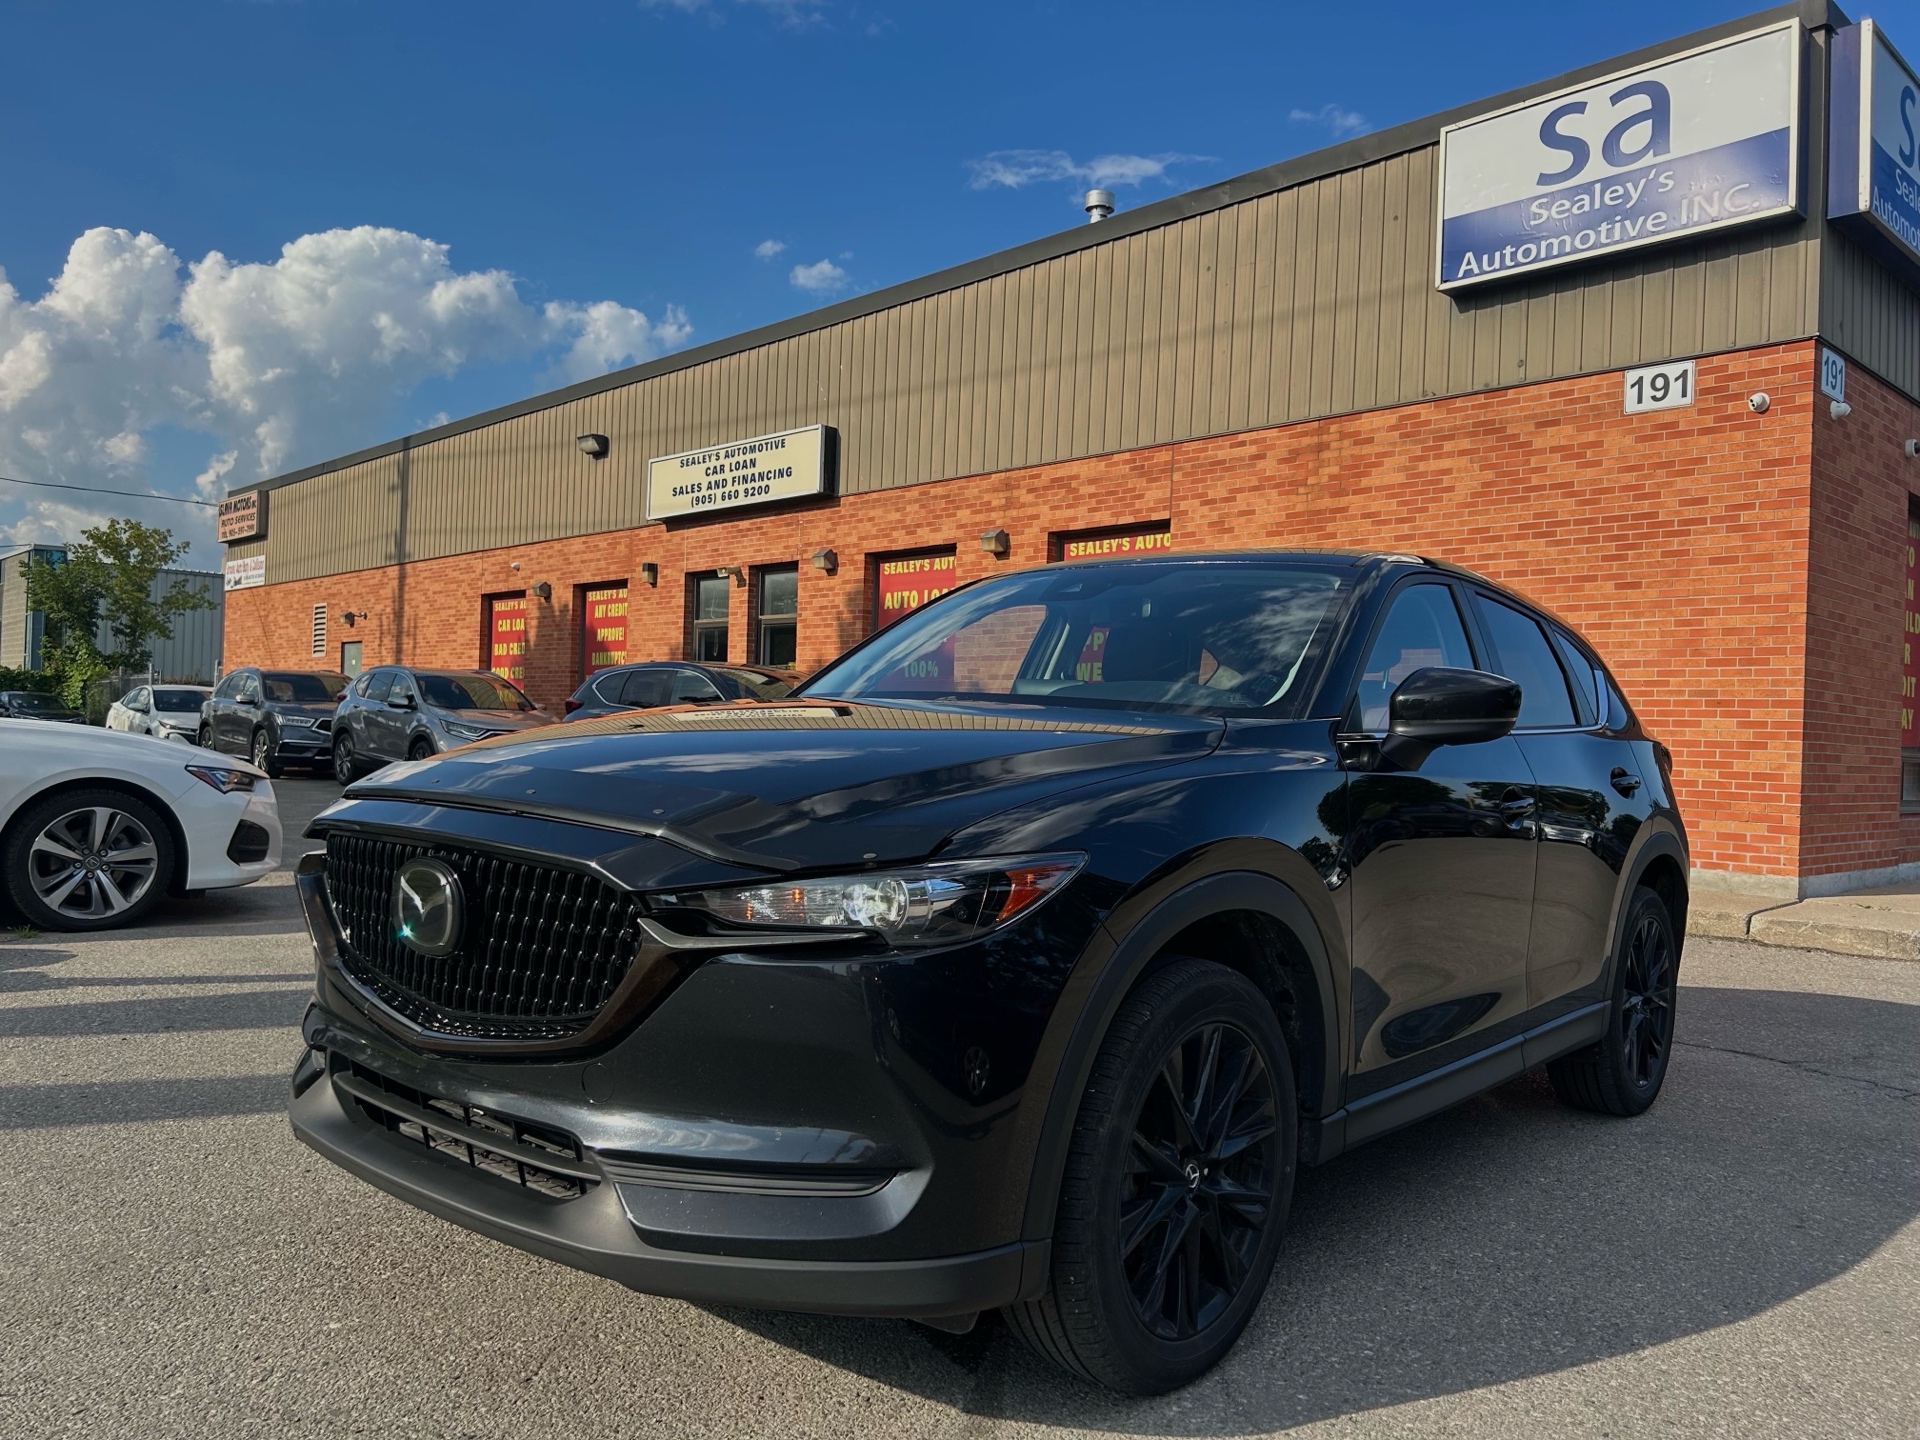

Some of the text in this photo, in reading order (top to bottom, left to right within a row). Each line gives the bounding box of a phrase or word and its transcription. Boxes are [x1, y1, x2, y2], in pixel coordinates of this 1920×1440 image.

[1536, 80, 1671, 186] sa
[1899, 85, 1920, 172] s
[1530, 169, 1674, 227] Sealey's
[1457, 183, 1760, 278] Automotive INC.
[1823, 355, 1844, 395] 191
[1629, 368, 1689, 405] 191
[680, 438, 786, 469] SEALEY'S AUTOMOTIVE
[705, 457, 756, 477] CAR LOAN
[672, 466, 792, 497] SALES AND FINANCING
[691, 484, 770, 508] (905) 660 9200
[221, 512, 256, 528] AUTO SERVICES
[1069, 532, 1171, 557] SEALEY'S AUTO
[883, 556, 956, 575] SEALEY'S AUT
[588, 590, 617, 602] SEALEY'S
[884, 590, 919, 610] AUTO
[494, 601, 519, 612] SEALEY'S
[594, 602, 628, 619] ANY CREDIT
[497, 619, 511, 633] CAR
[596, 627, 625, 642] APPROVE!
[494, 642, 508, 656] BAD
[510, 666, 525, 680] CRE
[903, 660, 939, 678] 100%
